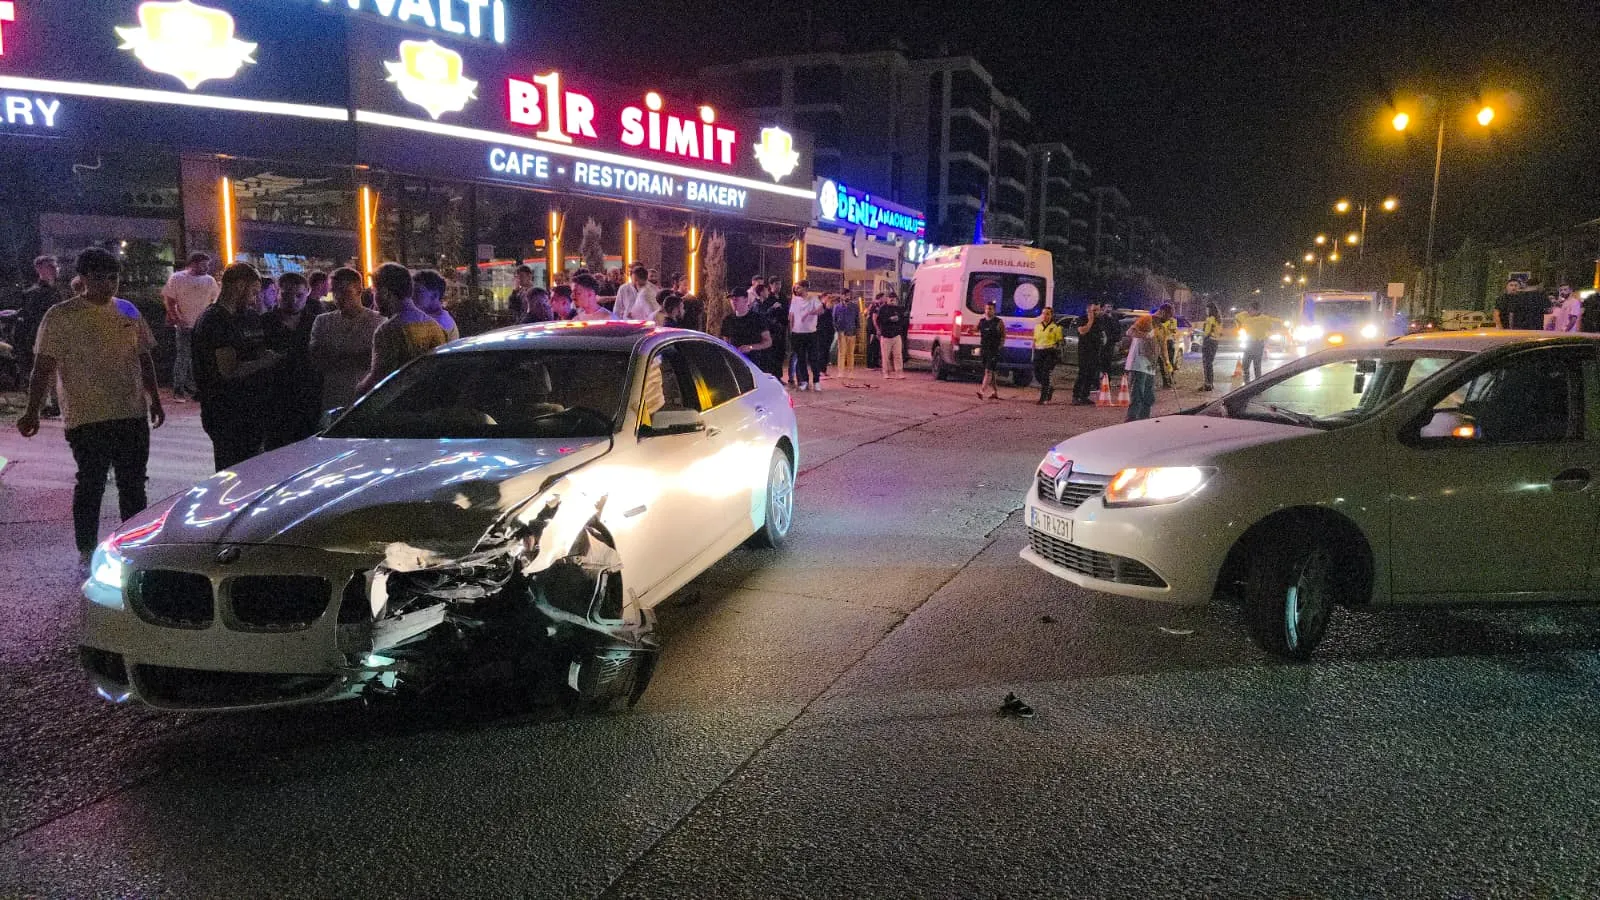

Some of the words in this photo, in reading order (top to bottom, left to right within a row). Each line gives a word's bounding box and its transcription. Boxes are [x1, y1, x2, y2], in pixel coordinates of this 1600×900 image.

[0, 95, 60, 127] RY
[489, 148, 549, 179] CAFE
[574, 161, 674, 197] RESTORAN
[686, 181, 748, 208] BAKERY
[981, 258, 1037, 269] AMBULANS
[1043, 513, 1051, 531] TR
[1052, 517, 1069, 538] 4231
